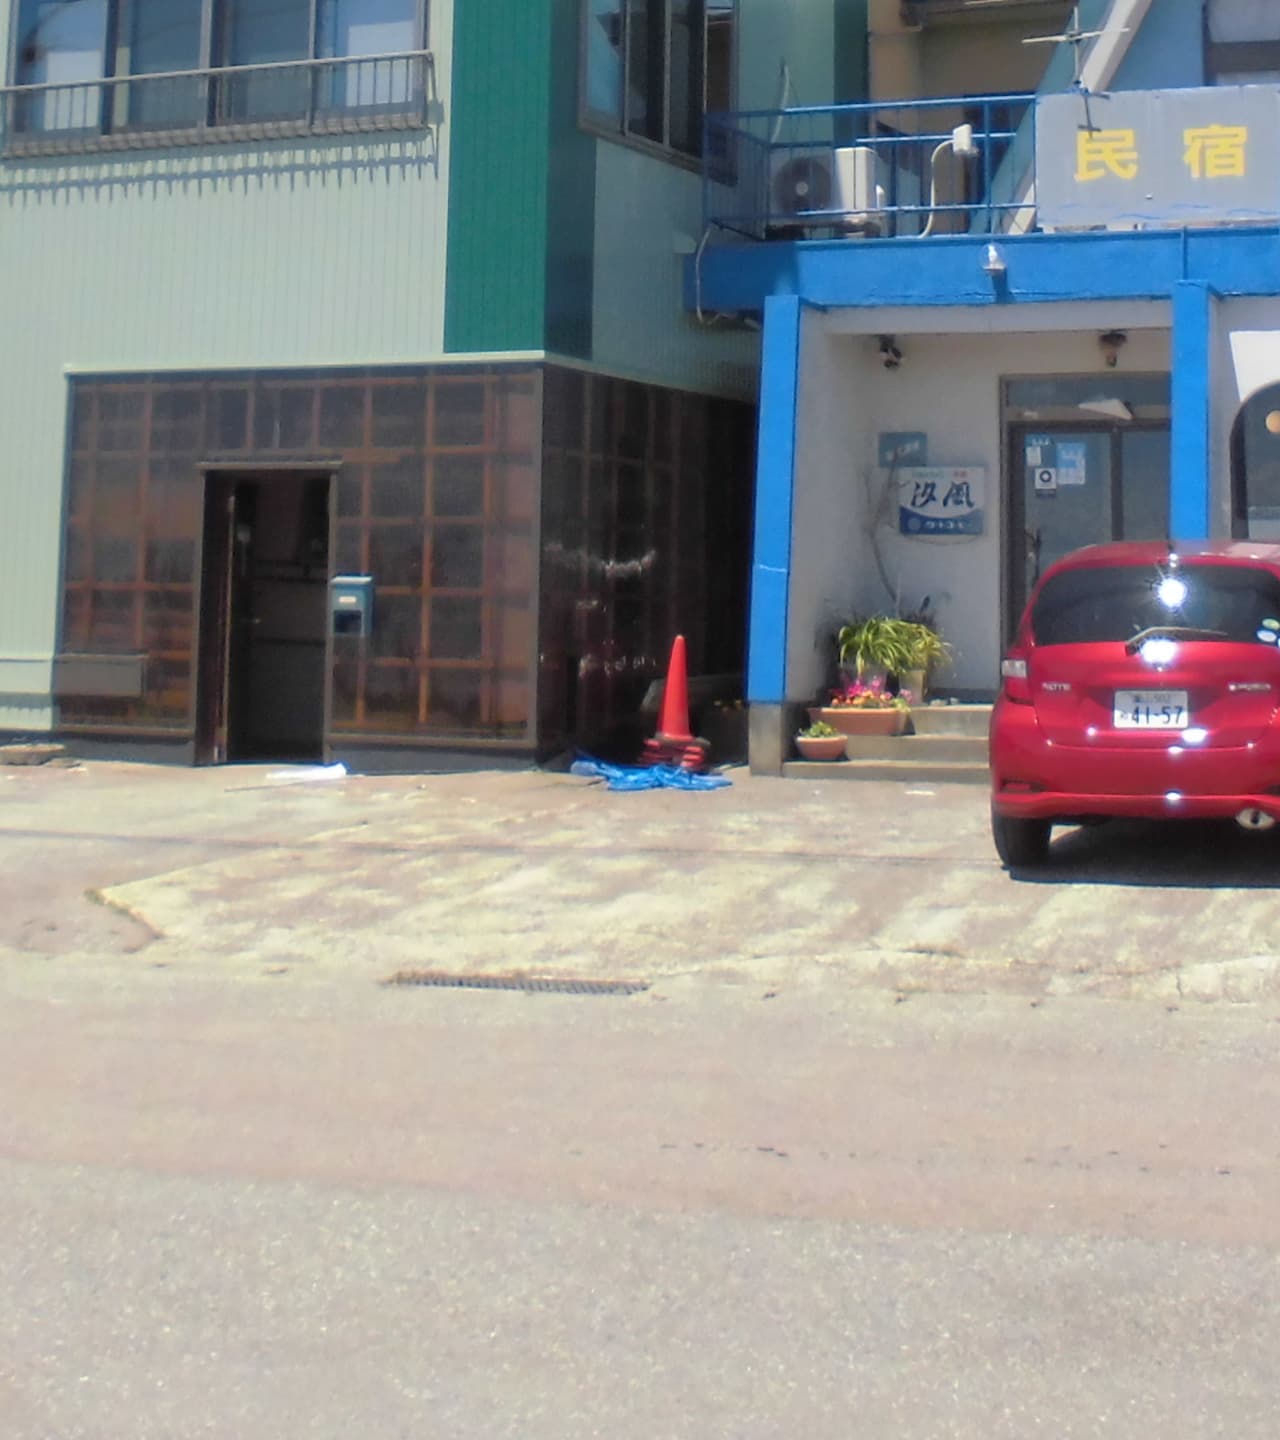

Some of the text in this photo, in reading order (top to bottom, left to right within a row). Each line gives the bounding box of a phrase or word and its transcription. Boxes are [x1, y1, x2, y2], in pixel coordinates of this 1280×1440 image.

[1073, 123, 1249, 182] 民宿
[911, 480, 974, 508] 汐風
[1131, 705, 1183, 724] 41-57
